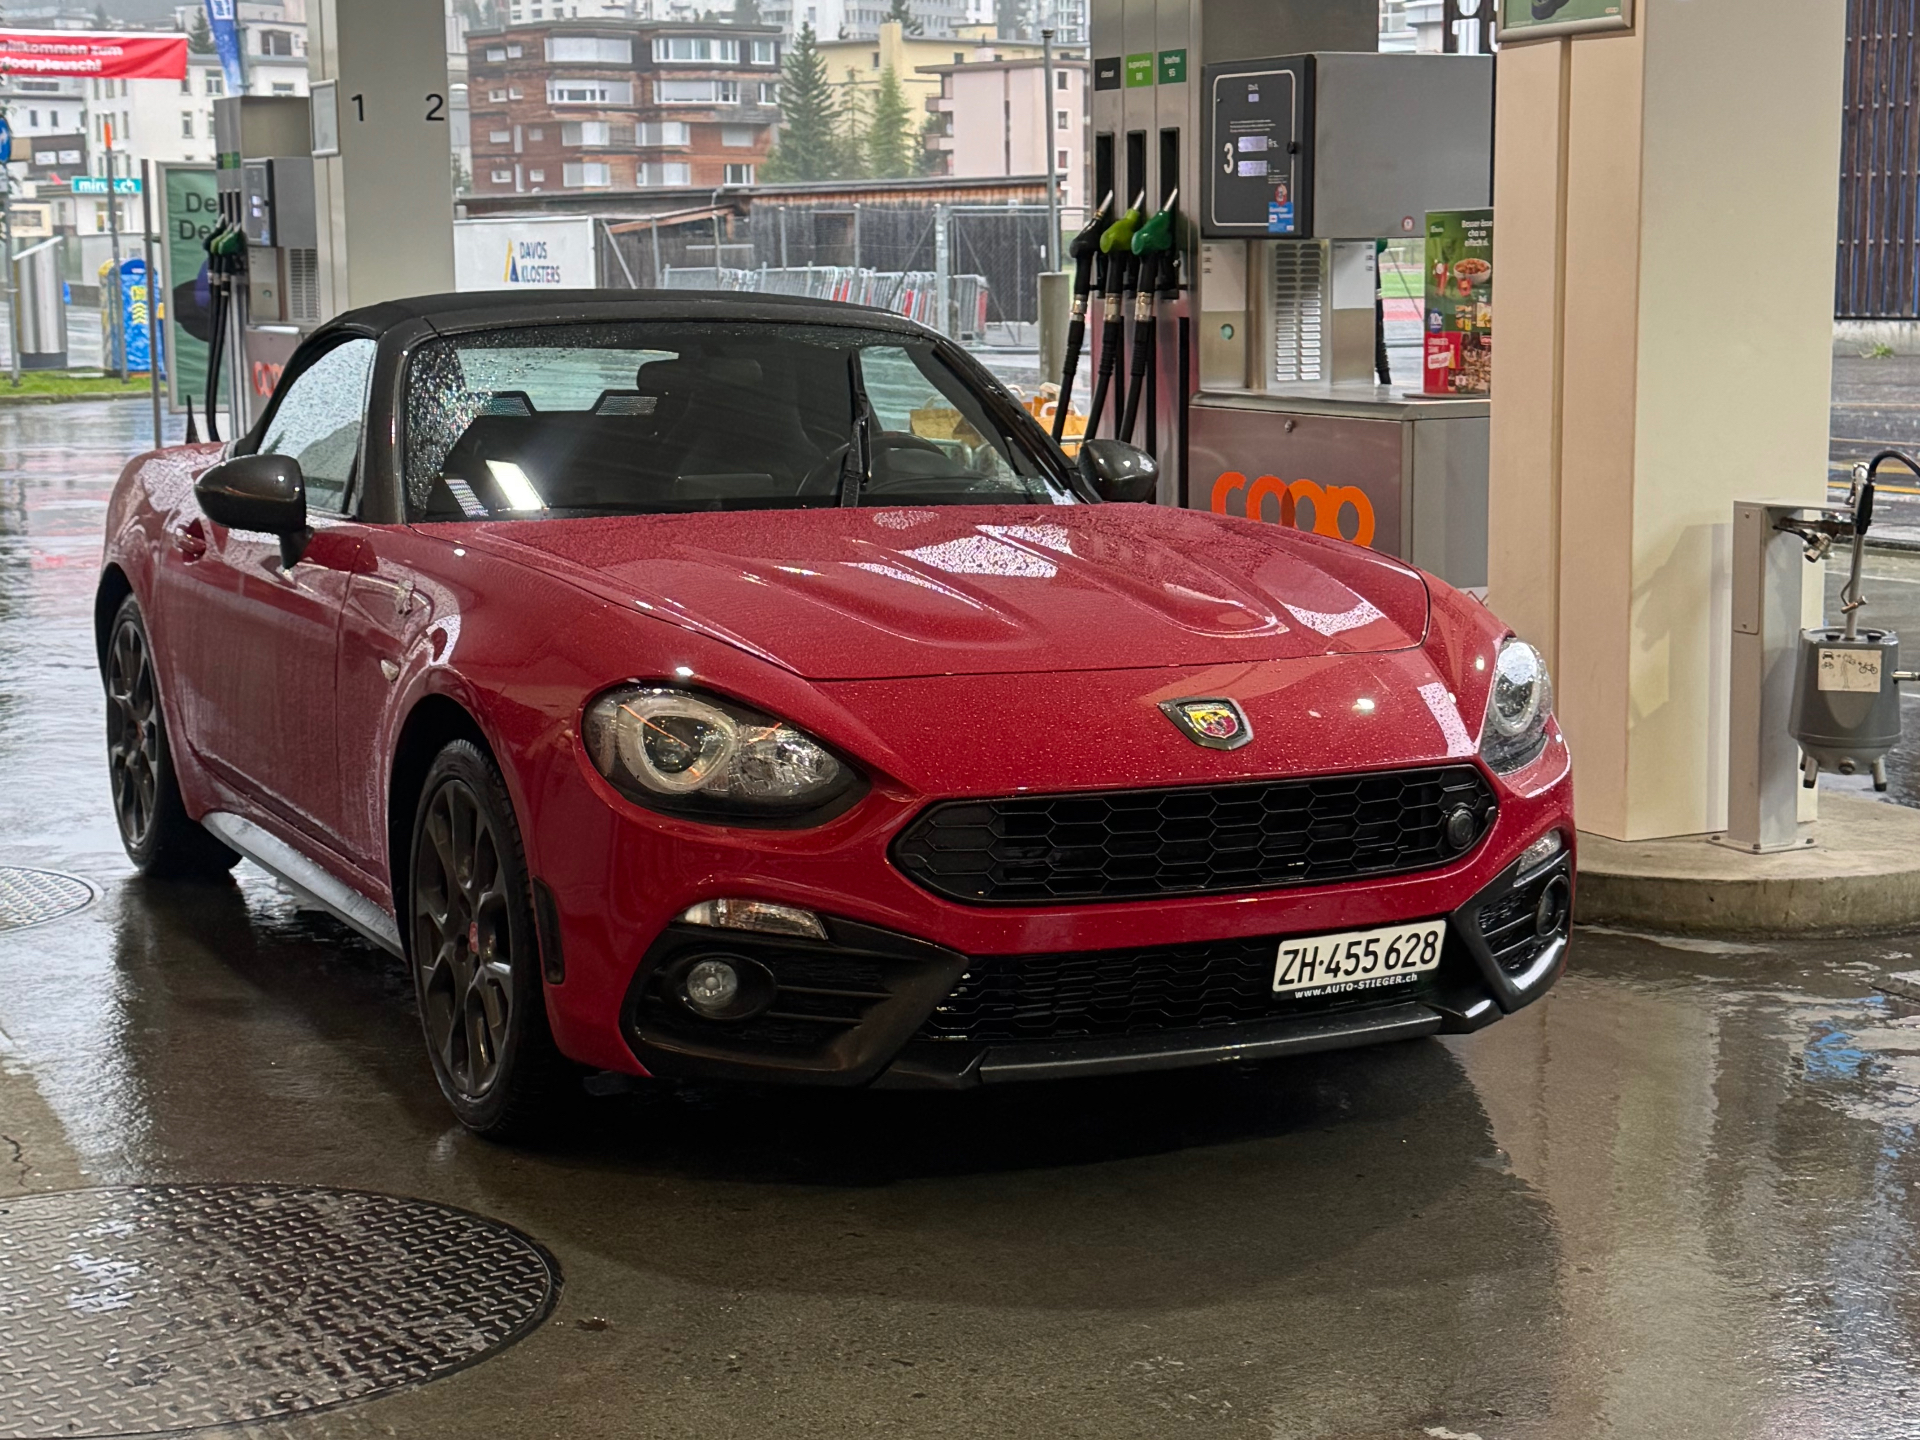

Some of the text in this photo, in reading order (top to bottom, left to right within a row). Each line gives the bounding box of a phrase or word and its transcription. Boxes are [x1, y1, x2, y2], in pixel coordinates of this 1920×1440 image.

[91, 45, 124, 56] zum
[351, 93, 364, 121] 1
[425, 93, 445, 121] 2
[1223, 142, 1234, 174] 3
[519, 241, 547, 260] DAVOS
[520, 265, 561, 284] KLOSTERS
[1211, 471, 1375, 547] coop
[1294, 973, 1418, 999] www.AUTO-STIEGER.ch
